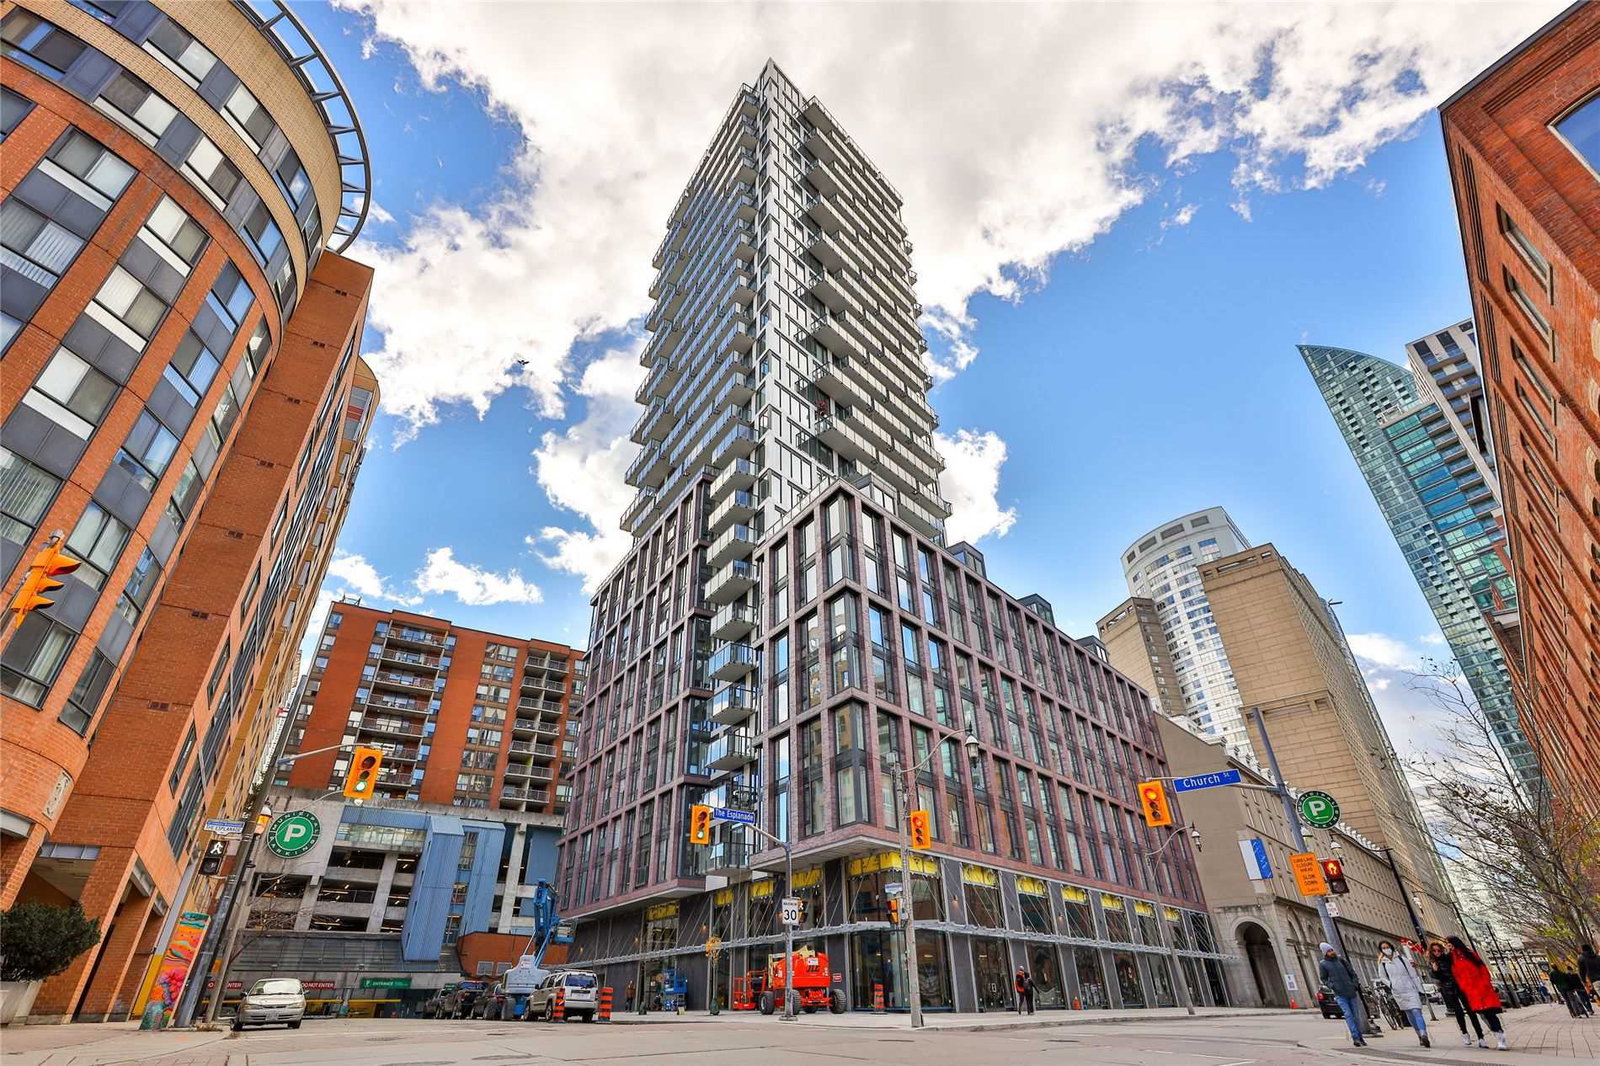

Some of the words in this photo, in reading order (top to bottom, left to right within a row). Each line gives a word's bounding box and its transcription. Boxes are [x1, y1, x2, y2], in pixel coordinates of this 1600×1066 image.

[1183, 774, 1220, 788] Church
[715, 808, 726, 817] The
[727, 810, 754, 822] Esplanade
[1308, 800, 1326, 816] P
[284, 823, 306, 842] P
[269, 836, 315, 856] PARKING
[784, 909, 797, 920] 30
